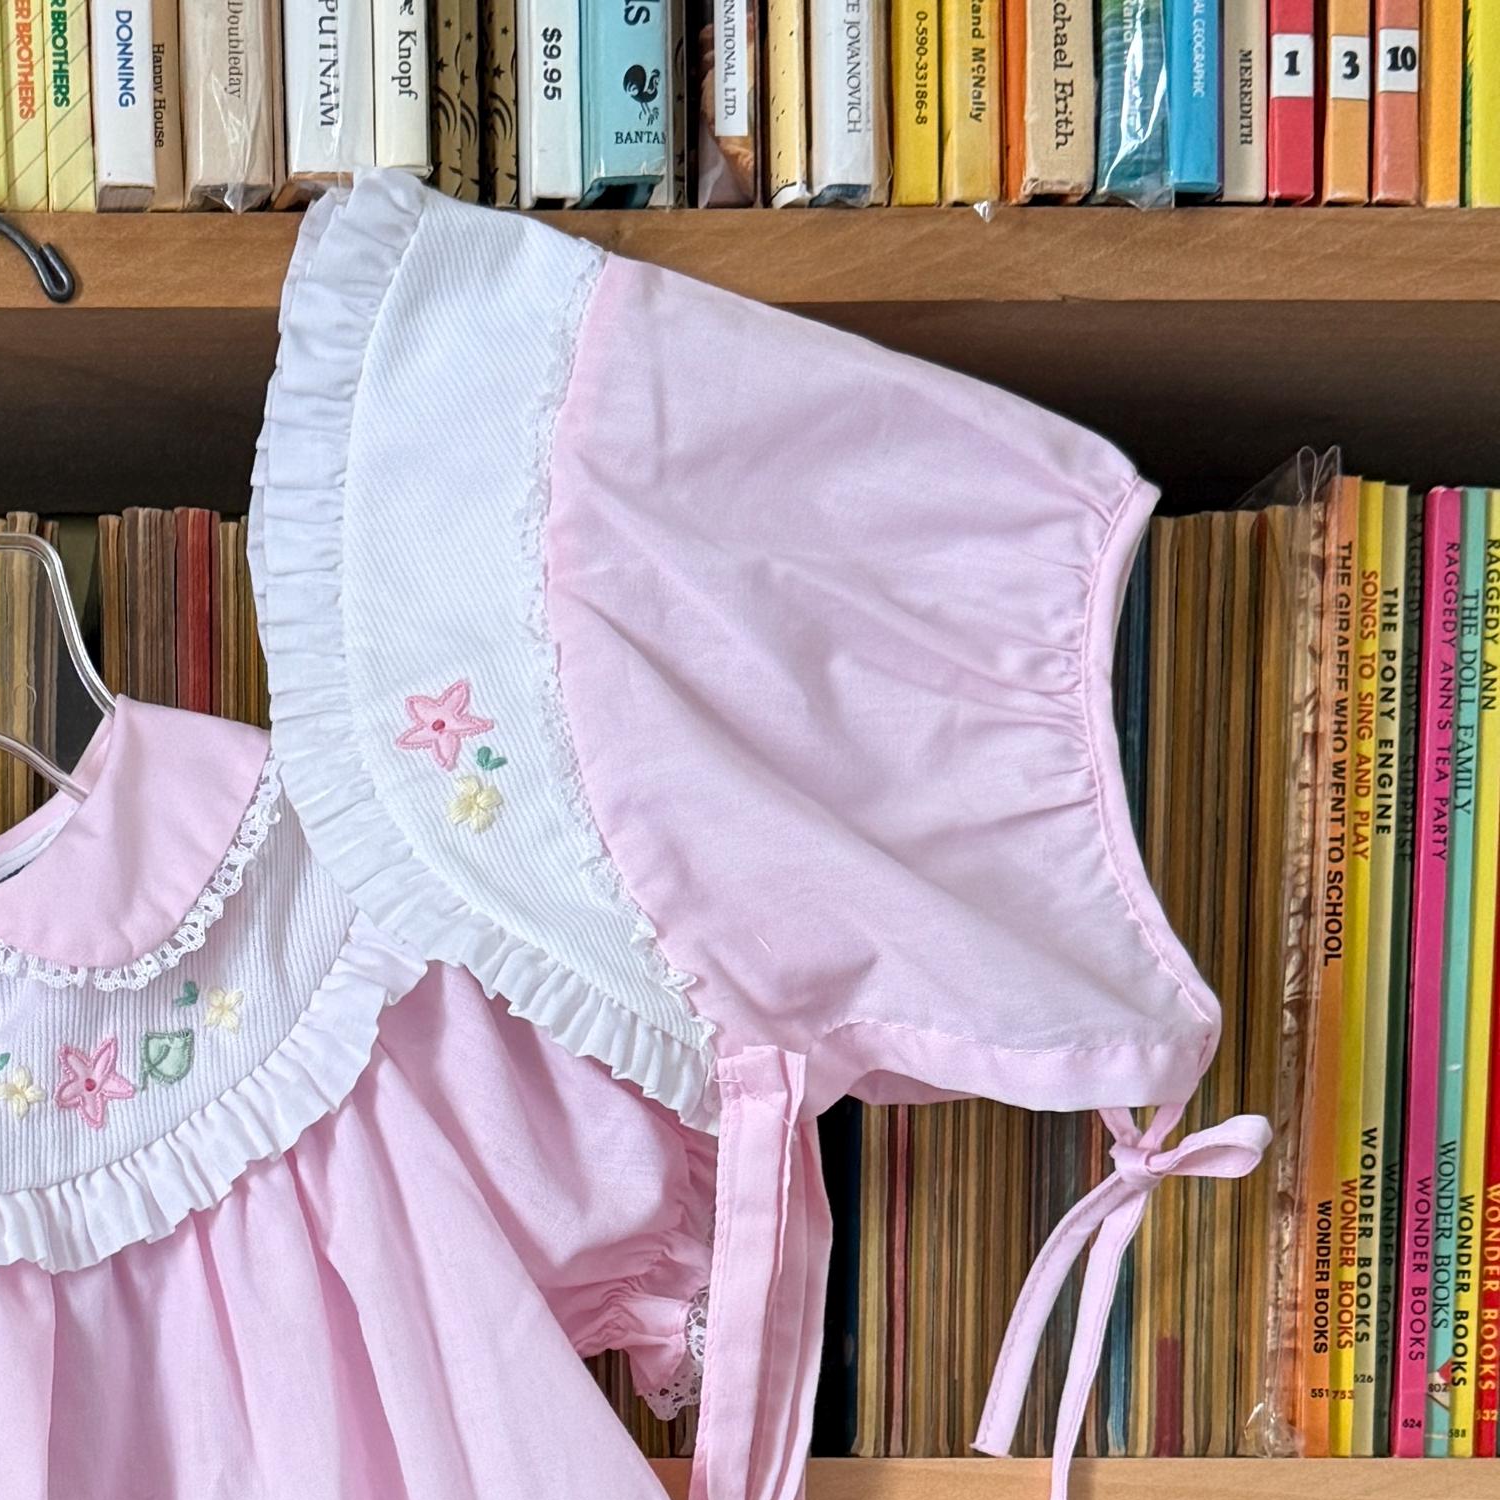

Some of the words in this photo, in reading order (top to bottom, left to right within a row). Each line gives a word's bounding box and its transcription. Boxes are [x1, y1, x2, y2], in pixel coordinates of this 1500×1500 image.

[15, 22, 36, 120] BROTHERS
[51, 12, 70, 108] BROTHERS
[115, 9, 136, 108] DONNING
[227, 0, 245, 98] Doubleday
[392, 29, 418, 100] Knopf
[541, 26, 563, 101] $9.95
[844, 19, 862, 134] JOVANOVICH
[915, 10, 929, 125] 0-590-33186-8
[1192, 18, 1206, 98] GEOGRAPHIC
[1284, 50, 1301, 76] 1
[1342, 51, 1360, 80] 3
[1386, 46, 1417, 71] 10
[726, 88, 737, 121] LTD.
[969, 47, 986, 123] McNally
[1054, 79, 1075, 149] Frith
[1239, 49, 1253, 146] MEREDITH
[152, 96, 165, 149] House
[1336, 540, 1352, 585] THE
[1441, 542, 1461, 647] RAGGEDY
[1483, 539, 1500, 645] RAGGEDY
[1359, 570, 1378, 641] SONGS
[1382, 588, 1398, 633] THE
[1461, 589, 1479, 637] THE
[1334, 595, 1351, 691] GIRAFFE
[1358, 653, 1376, 680] TO
[1379, 650, 1397, 721] PONY
[1436, 662, 1455, 730] ANN'S
[1457, 650, 1477, 711] DOLL
[1480, 660, 1498, 711] ANN
[1332, 698, 1348, 753] WHO
[1356, 692, 1374, 741] SING
[1330, 760, 1347, 826] WENT
[1354, 753, 1371, 798] AND
[1376, 739, 1394, 835] ENGINE
[1434, 745, 1450, 782] TEA
[1454, 725, 1474, 816] FAMILY
[1329, 833, 1345, 864] TO
[1352, 809, 1370, 861] PLAY
[1432, 797, 1449, 861] PARTY
[1323, 869, 1344, 967] SCHOOL
[1357, 1127, 1378, 1239] WONDER
[1434, 1140, 1457, 1240] WONDER
[1315, 1199, 1332, 1283] WONDER
[1338, 1178, 1358, 1269] WONDER
[1410, 1176, 1433, 1274] WONDER
[1455, 1195, 1476, 1293] WONDER
[1481, 1184, 1500, 1292] WONDER
[1313, 1289, 1329, 1354] BOOKS
[1337, 1281, 1355, 1350] BOOKS
[1355, 1257, 1373, 1343] BOOKS
[1409, 1286, 1427, 1361] BOOKS
[1430, 1254, 1451, 1329] BOOKS
[1451, 1310, 1470, 1388] BOOKS
[1478, 1308, 1496, 1391] BOOKS
[1310, 1388, 1329, 1398] 551
[1332, 1390, 1355, 1400] 753
[1402, 1418, 1422, 1429] 624
